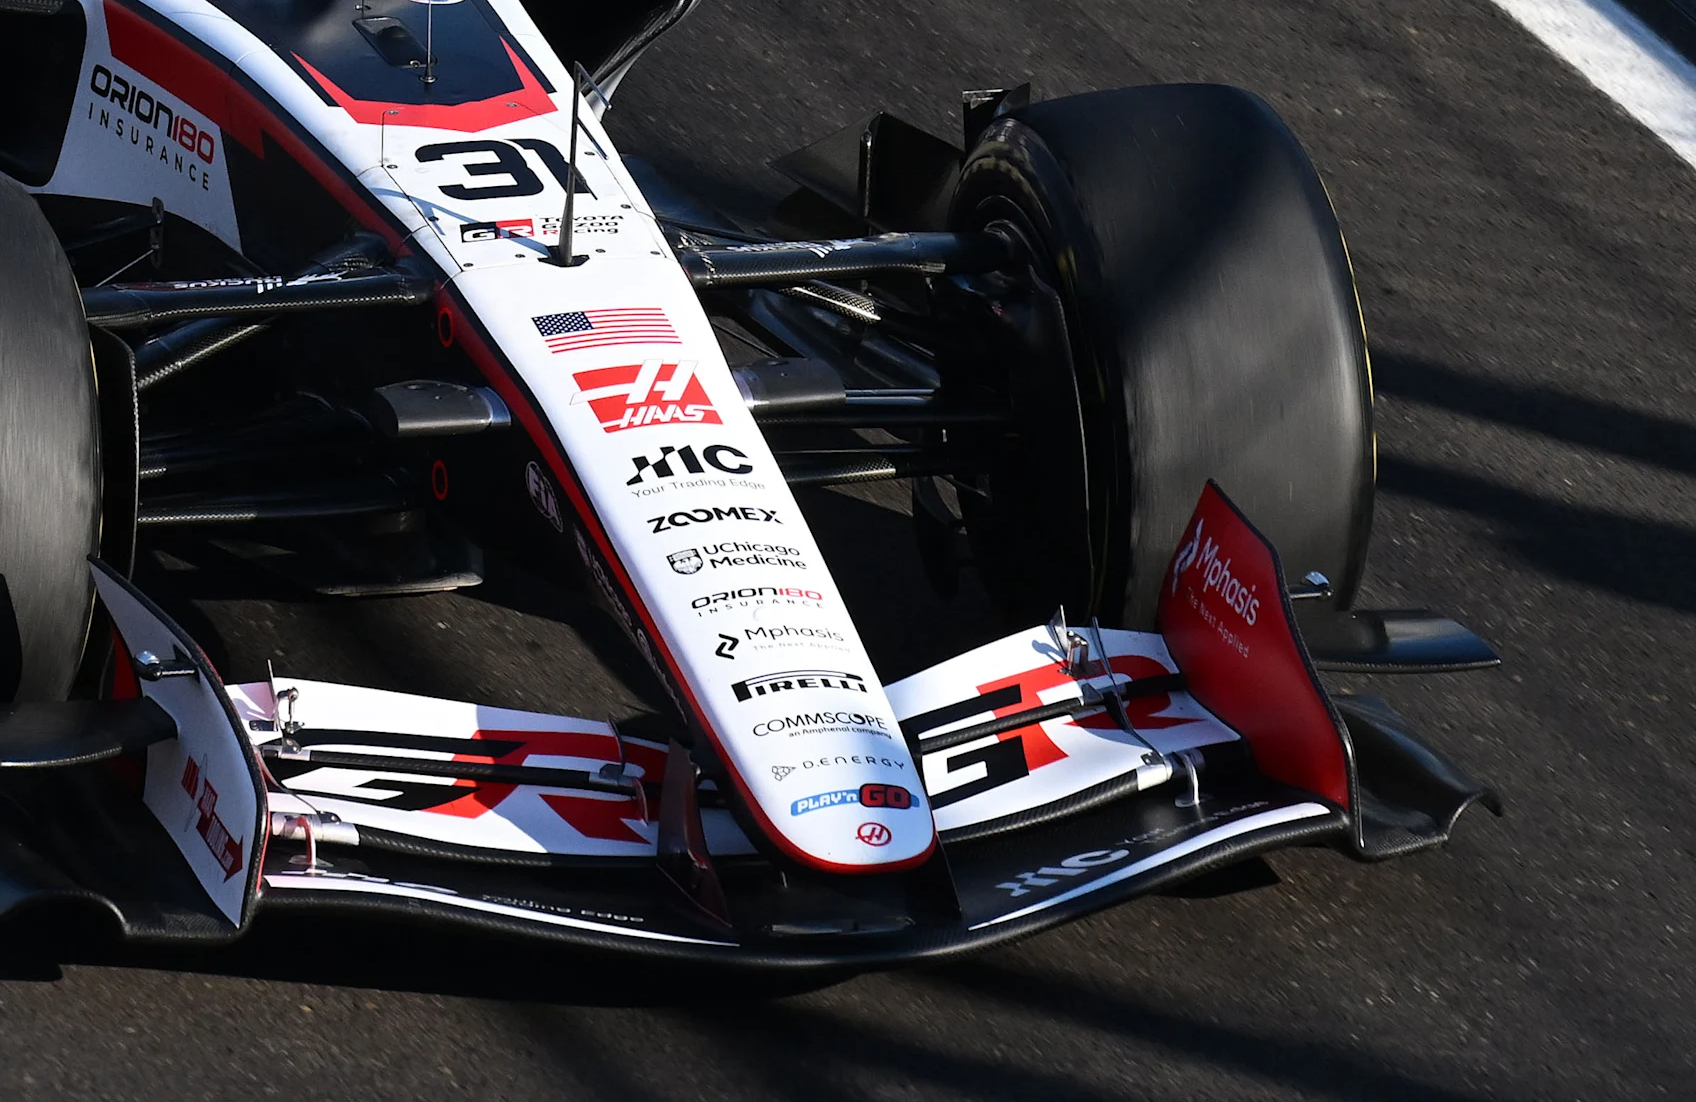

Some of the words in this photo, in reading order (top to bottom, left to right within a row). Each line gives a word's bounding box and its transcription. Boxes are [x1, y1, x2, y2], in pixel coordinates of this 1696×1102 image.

[90, 64, 215, 165] ORION180
[88, 102, 210, 191] INSURANCE
[414, 138, 592, 201] 31
[602, 404, 717, 429] HAAS
[631, 485, 666, 498] Your
[670, 478, 726, 490] Trading
[730, 478, 766, 491] Edge
[647, 507, 784, 534] ZOOMEX
[703, 541, 800, 557] UChicago
[709, 554, 807, 570] Medicine
[1196, 536, 1260, 626] Mphasis
[691, 587, 823, 609] ORION180
[697, 598, 824, 617] INSURANCE
[744, 625, 844, 642] Mphasis
[1200, 604, 1217, 629] Next
[1217, 620, 1250, 659] Applied
[731, 670, 868, 702] PIRELLI
[753, 711, 888, 737] COMMSCOPE
[802, 726, 851, 736] Amphenol
[851, 727, 892, 740] company
[797, 792, 858, 814] PLAY'n
[861, 784, 912, 809] GO
